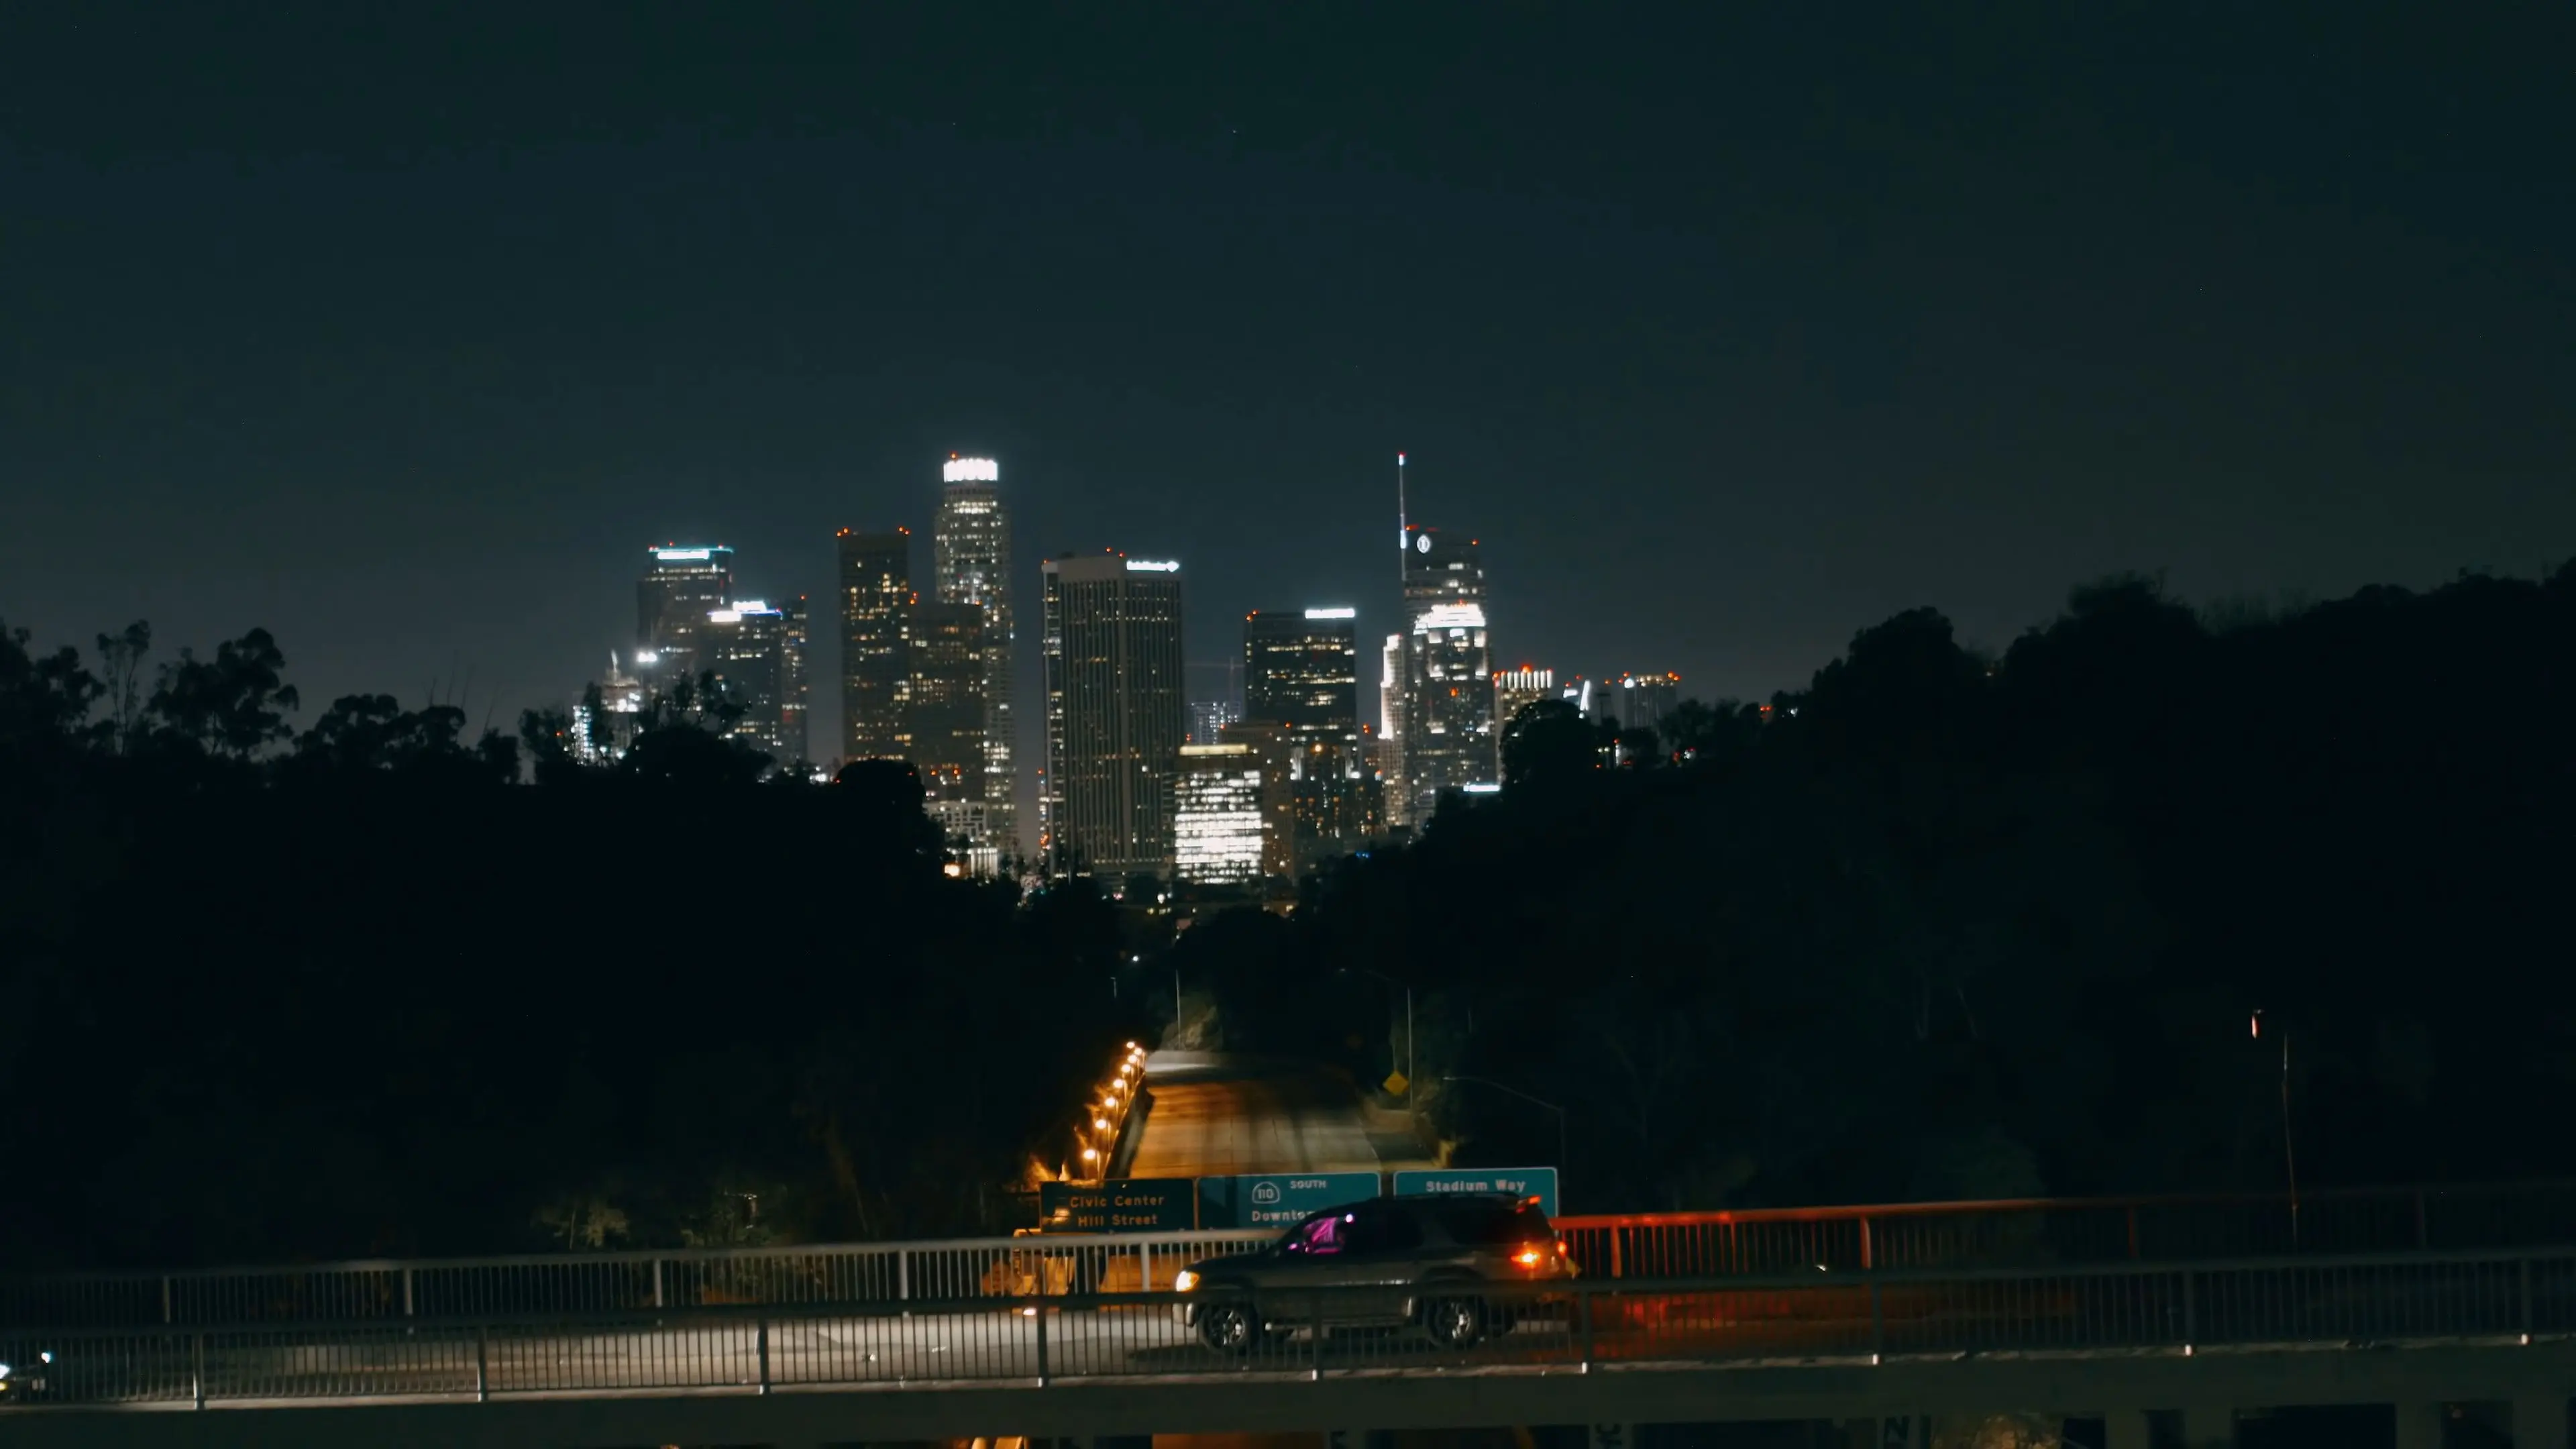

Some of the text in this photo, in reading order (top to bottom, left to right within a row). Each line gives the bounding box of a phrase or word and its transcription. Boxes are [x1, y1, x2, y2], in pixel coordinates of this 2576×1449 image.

[1291, 1180, 1326, 1189] SOUTH
[1426, 1179, 1525, 1192] Stadium Way
[1258, 1189, 1273, 1199] 110
[1071, 1195, 1164, 1208] Civic Center
[1078, 1214, 1158, 1226] Hill Street
[1252, 1210, 1316, 1222] Downto
